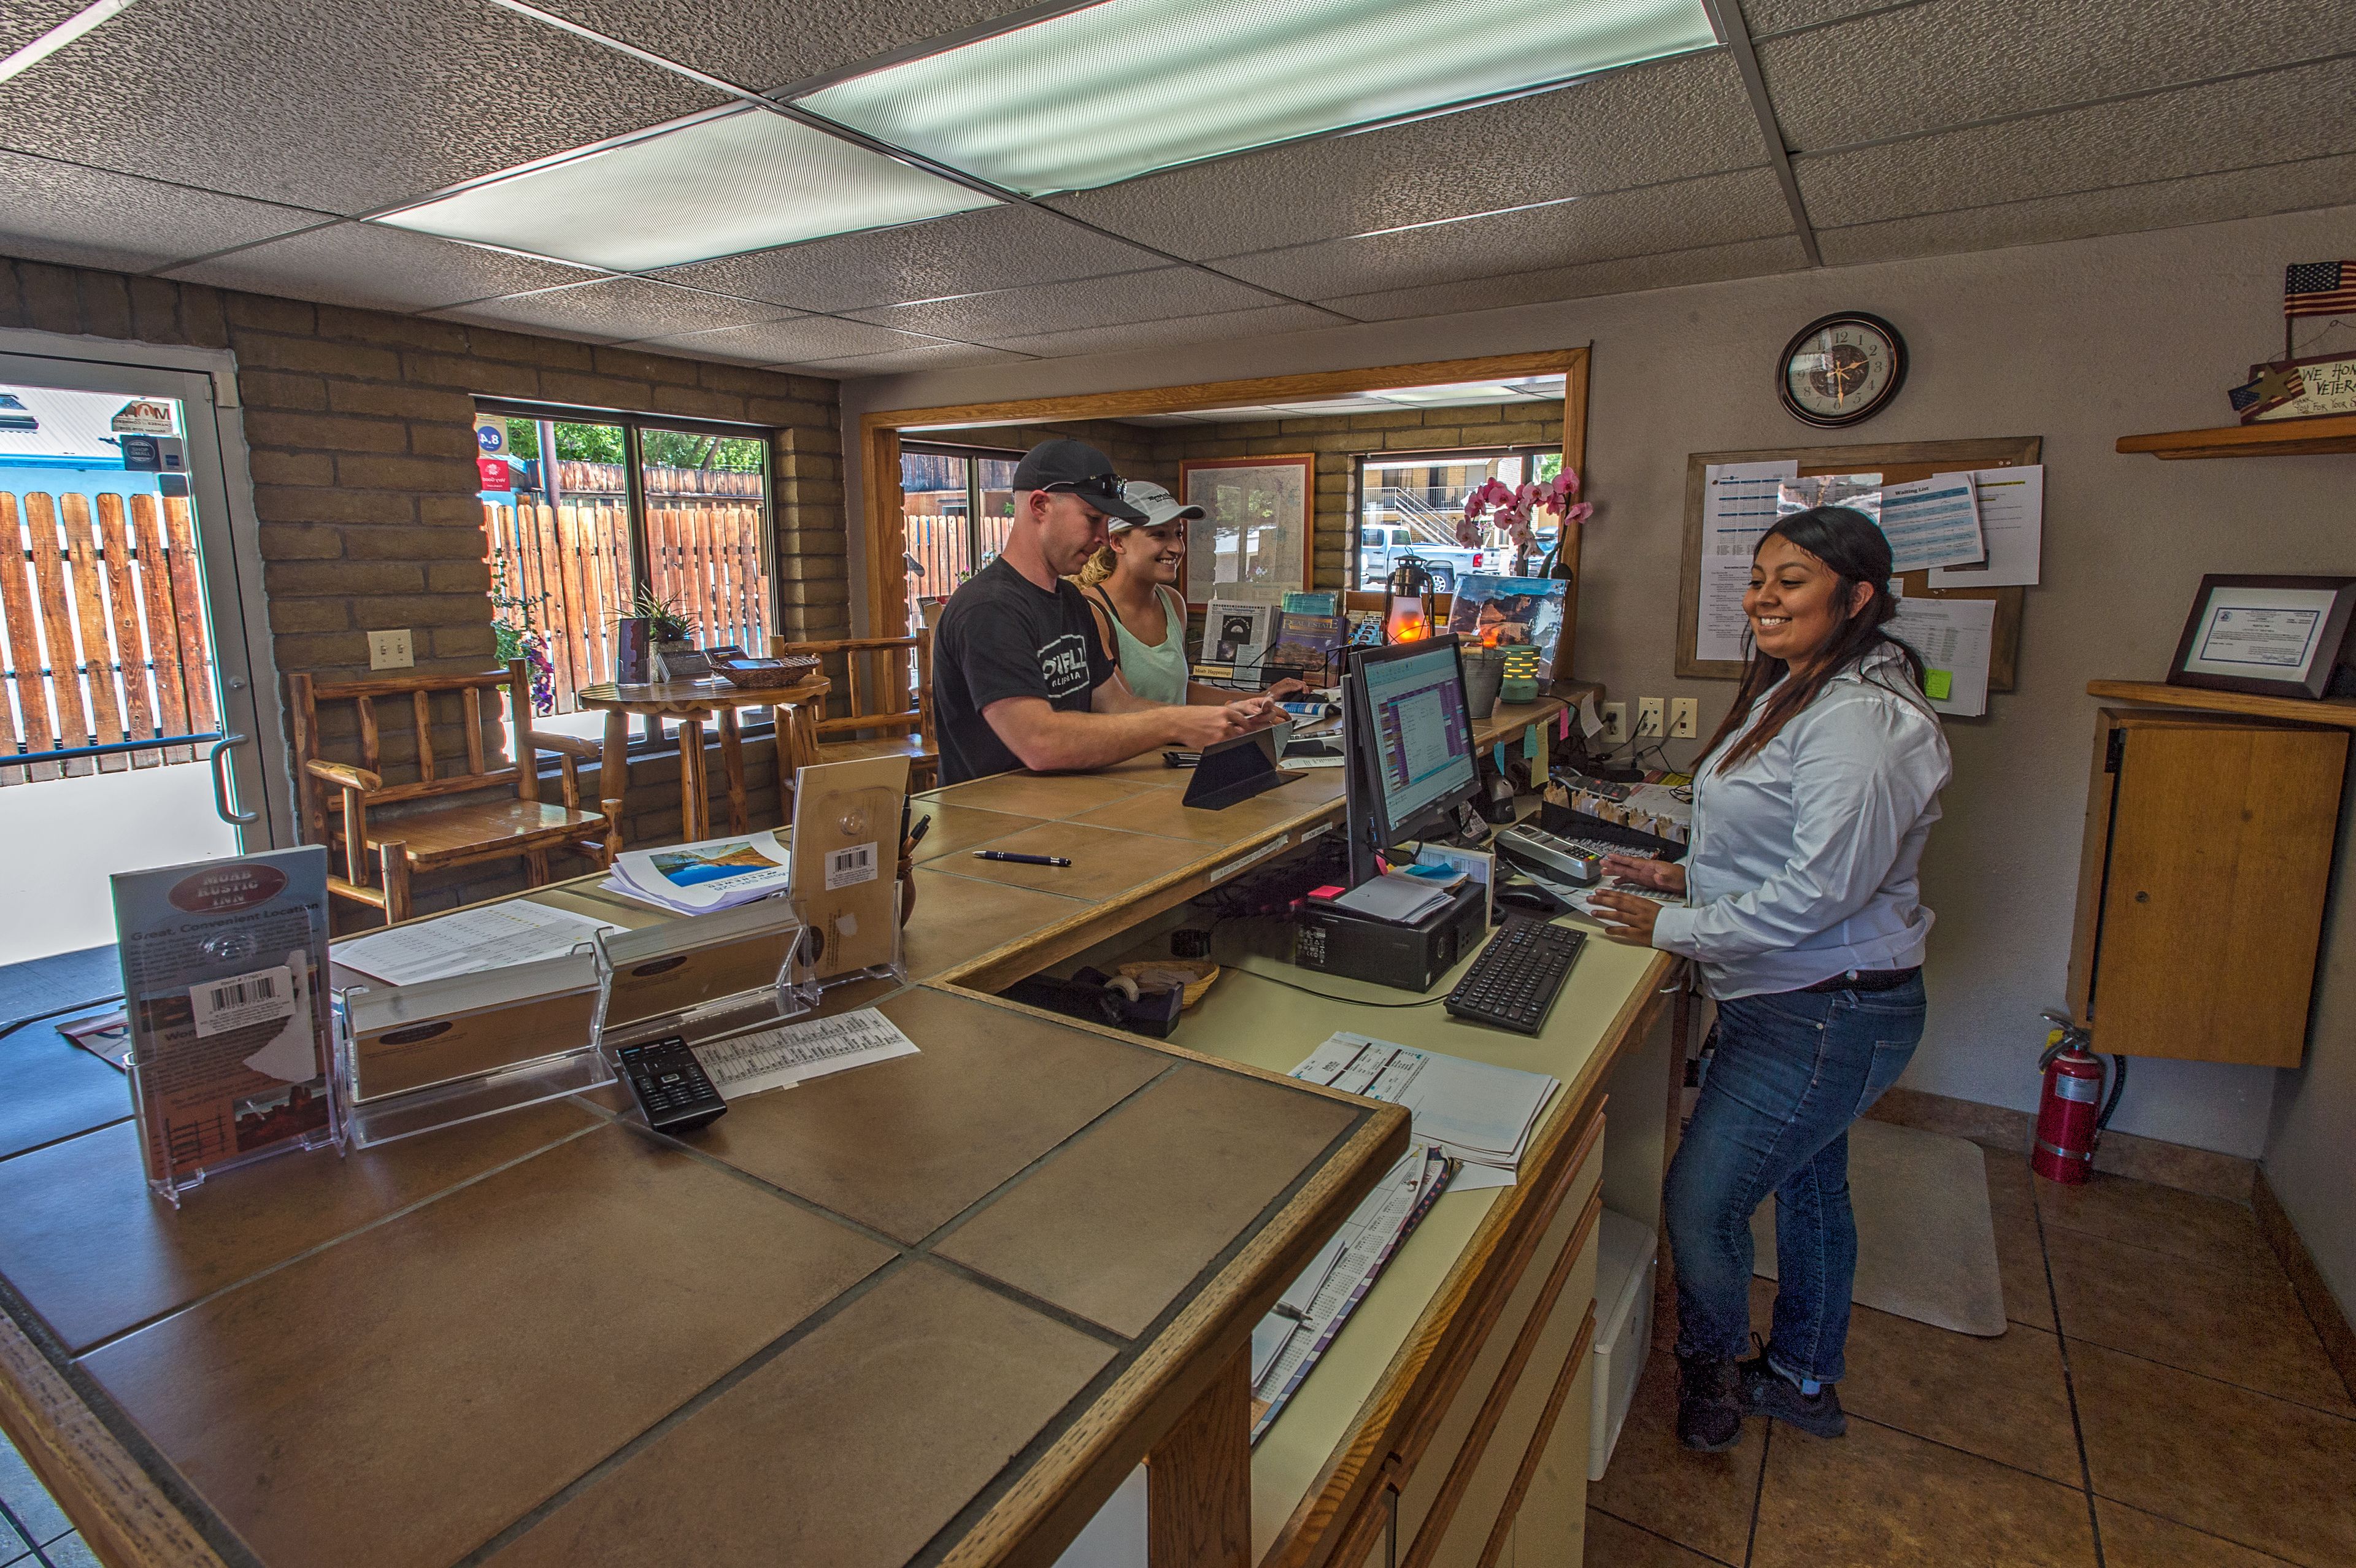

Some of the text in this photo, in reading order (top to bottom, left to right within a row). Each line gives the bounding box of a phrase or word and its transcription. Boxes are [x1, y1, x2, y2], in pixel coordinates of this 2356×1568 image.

[1835, 331, 1849, 344] 12
[1858, 334, 1863, 345] 1
[1869, 345, 1877, 356] 2
[1874, 361, 1882, 373] 3
[1797, 370, 1806, 381] 9
[2302, 367, 2322, 382] WE
[1867, 380, 1876, 390] 4
[2317, 380, 2356, 396] VETER
[1803, 387, 1811, 398] 8
[1853, 392, 1862, 404] 5
[1833, 399, 1841, 410] 6
[2313, 402, 2328, 411] FOR
[1283, 618, 1338, 629] REAL ESTATE
[204, 872, 252, 885] MOAB
[198, 882, 259, 897] RUSTIC
[214, 896, 244, 906] INN
[180, 913, 260, 933] Convenient
[263, 902, 320, 918] Location
[1423, 1161, 1441, 1185] JULY 2019
